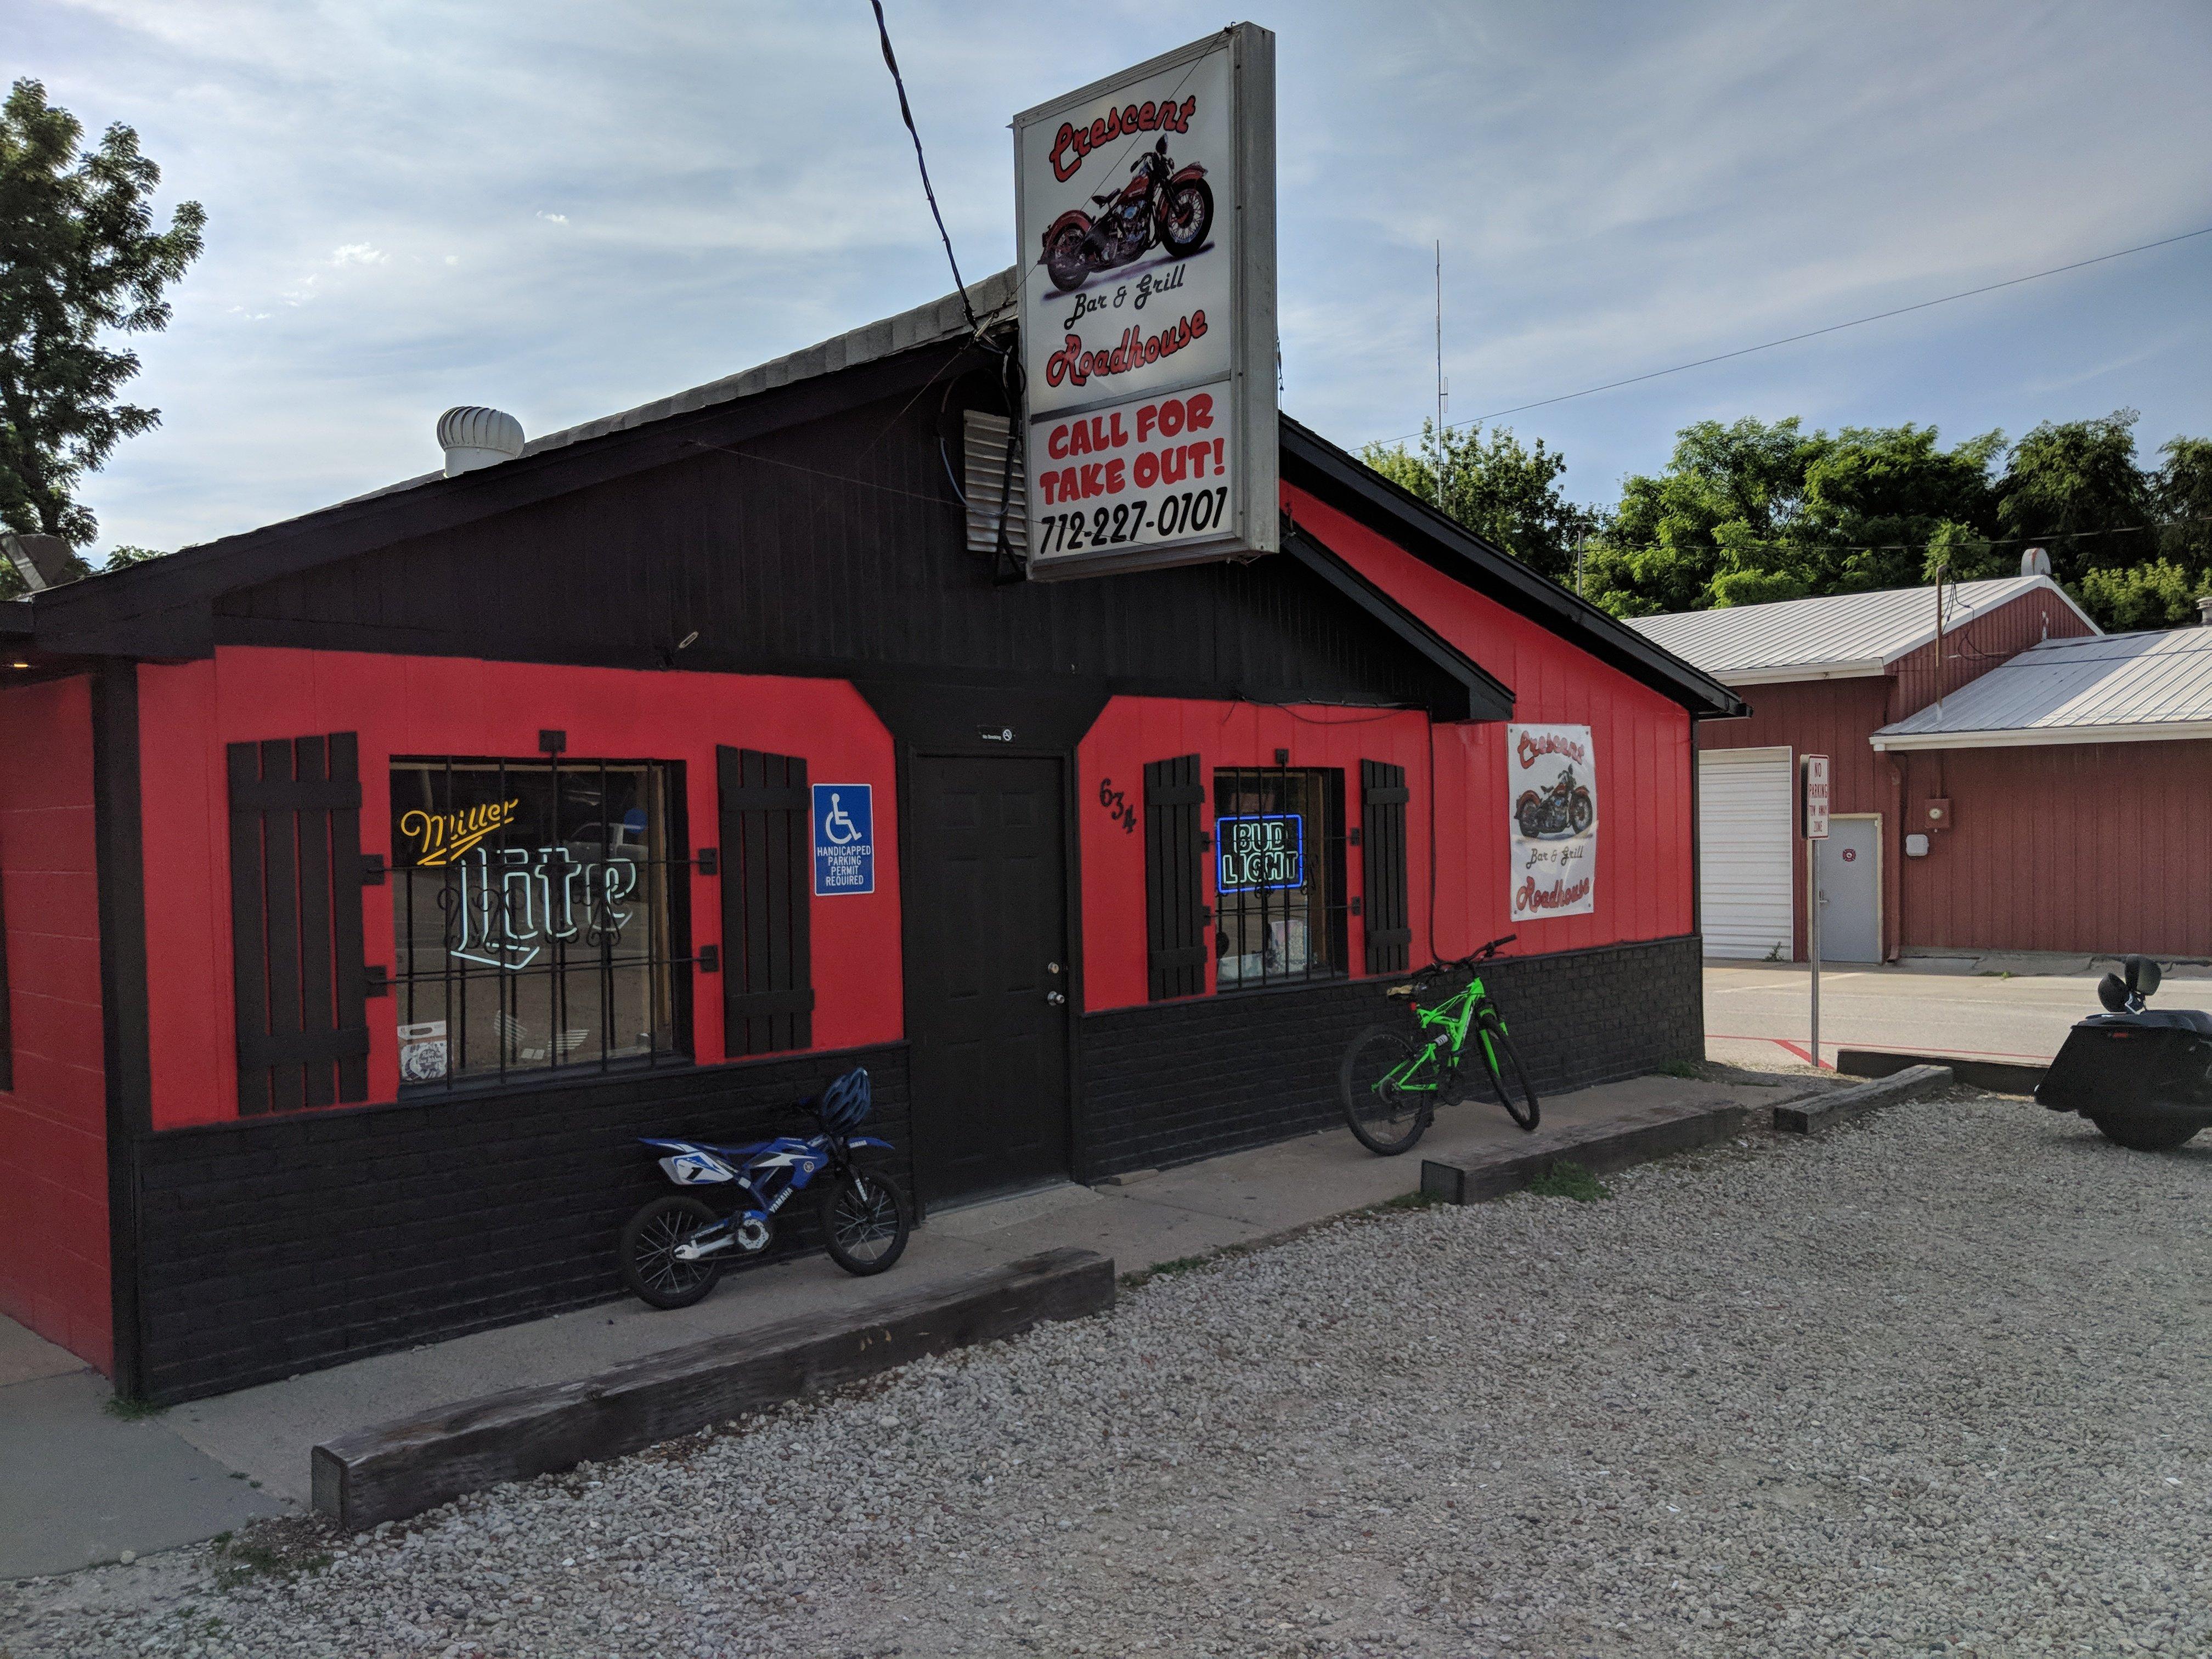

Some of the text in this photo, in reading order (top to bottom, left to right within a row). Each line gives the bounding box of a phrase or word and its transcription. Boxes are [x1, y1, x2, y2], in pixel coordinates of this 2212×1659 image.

[1049, 95, 1196, 183] Crescent
[1064, 263, 1187, 330] Bar & Grill
[1046, 309, 1208, 387] Roadhouse
[1048, 392, 1214, 460] CALL FOR
[1040, 438, 1225, 505] TAKE OUT!
[1040, 486, 1228, 555] 712-227-0107
[1517, 730, 1585, 769] Crescent
[1814, 762, 1822, 778] NO
[1099, 778, 1137, 834] 634
[1809, 783, 1827, 798] PARKING
[400, 798, 520, 853] Miller
[1233, 822, 1288, 854] BUD
[1814, 821, 1822, 832] ZONE
[817, 845, 871, 856] HANDICAPPED
[828, 855, 861, 866] PARKING
[1222, 850, 1299, 884] LIGHT
[1526, 845, 1583, 870] Bar & Grill
[826, 875, 864, 886] REQUIRED
[831, 865, 859, 876] PERMIT
[1516, 876, 1590, 913] Roadhouse
[685, 1167, 704, 1180] 1
[769, 1187, 793, 1214] YAMAHA
